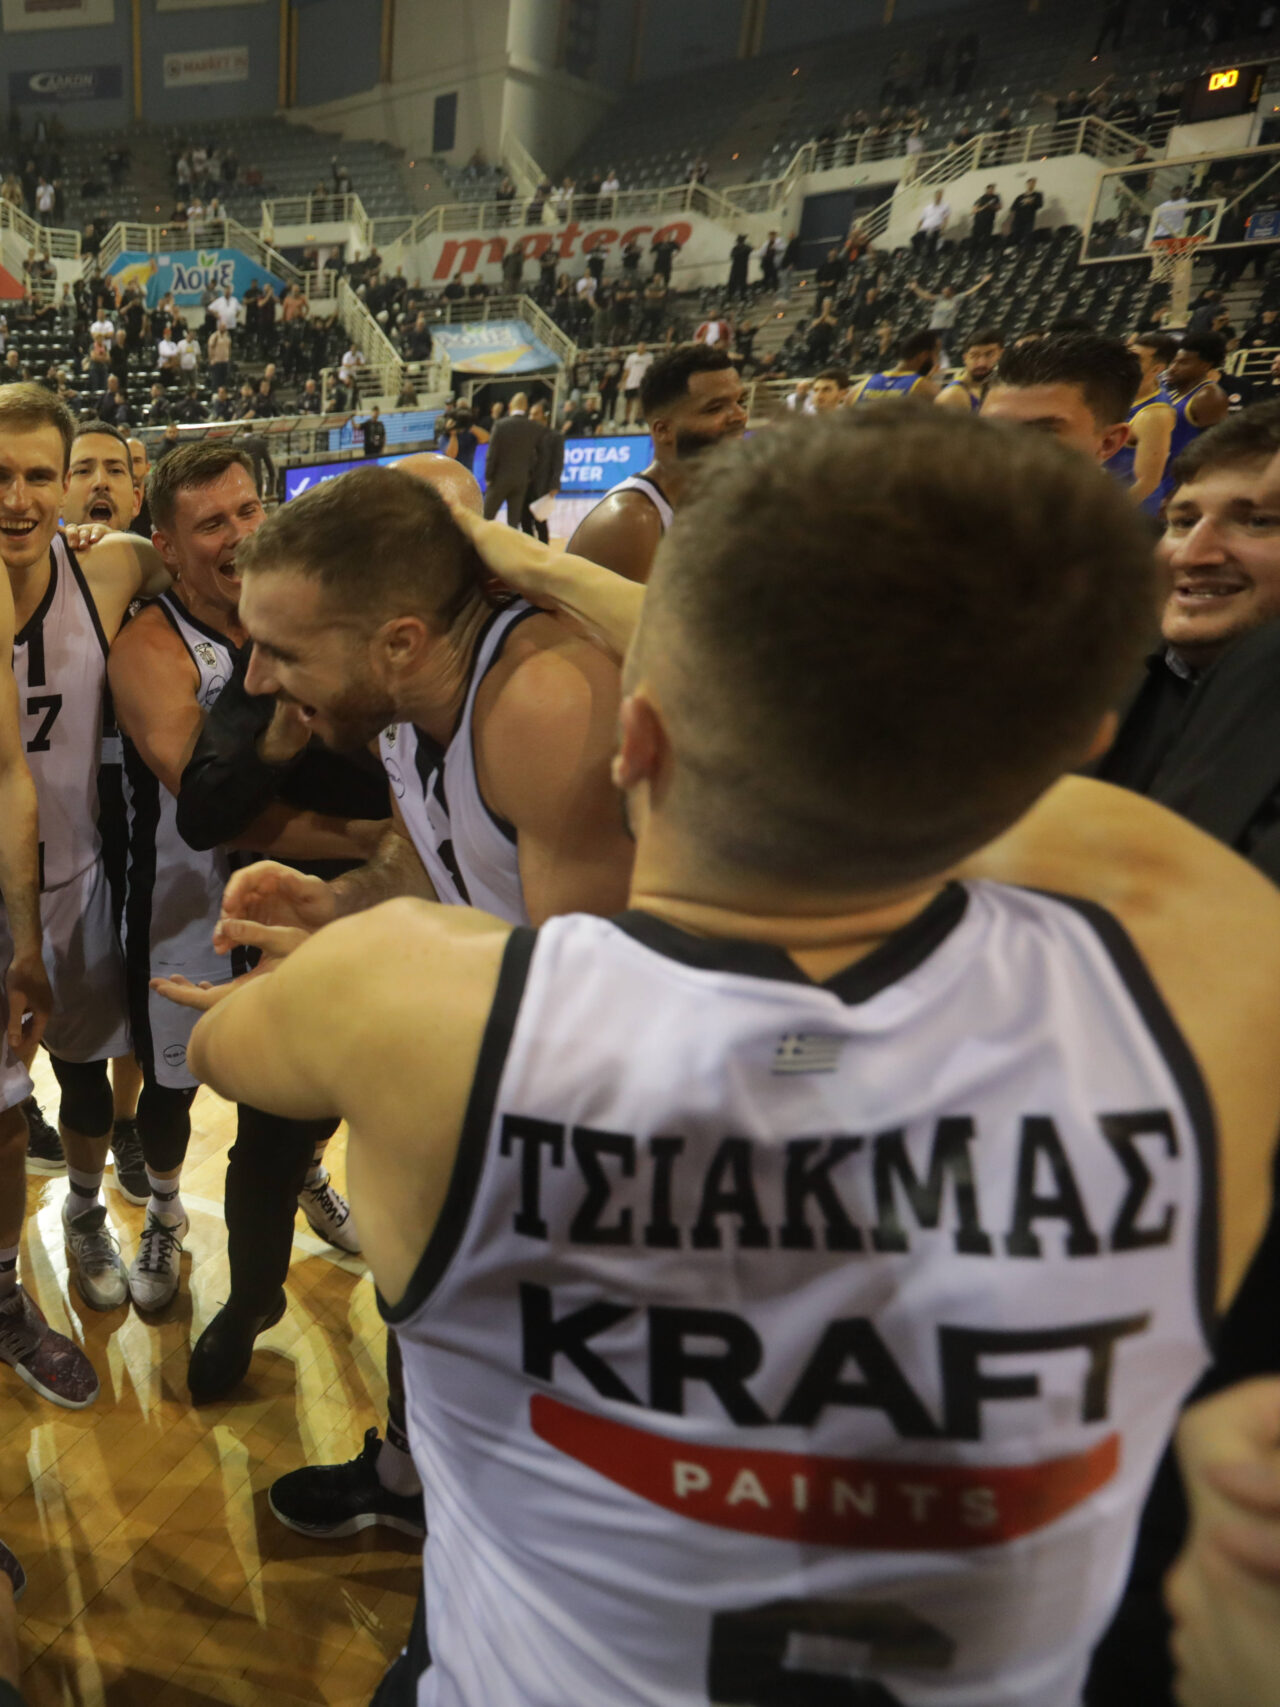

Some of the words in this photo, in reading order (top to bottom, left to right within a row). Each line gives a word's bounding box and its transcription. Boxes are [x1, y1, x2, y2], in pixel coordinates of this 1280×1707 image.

[432, 221, 693, 280] mateco
[499, 1108, 1180, 1259] ΤΣΙΑΚΜΑΣ
[520, 1284, 1153, 1442] KRAFT
[673, 1460, 999, 1528] PAINTS
